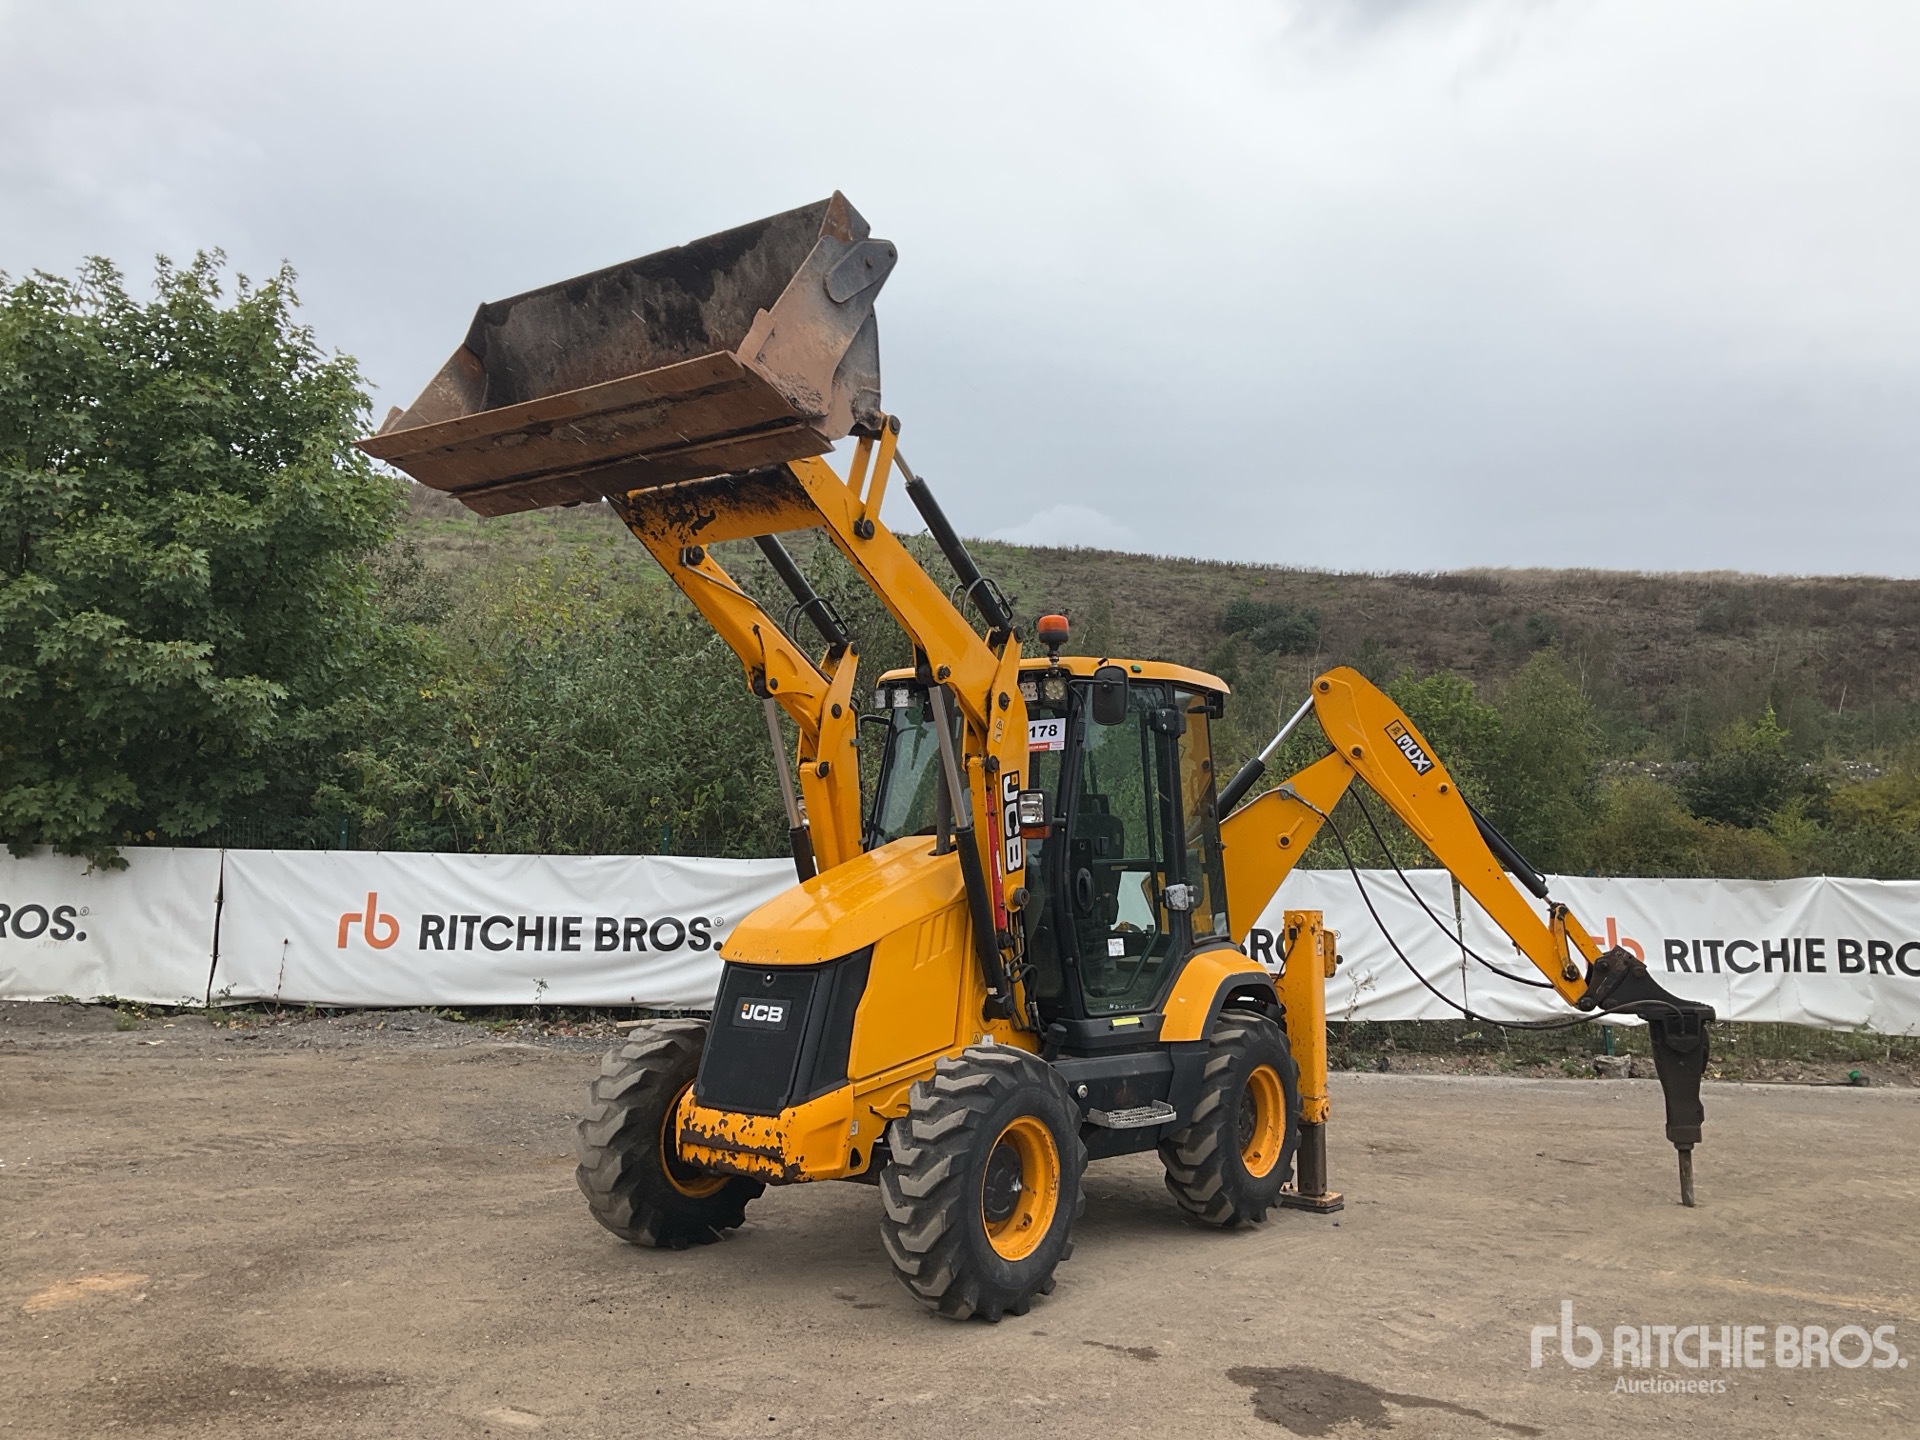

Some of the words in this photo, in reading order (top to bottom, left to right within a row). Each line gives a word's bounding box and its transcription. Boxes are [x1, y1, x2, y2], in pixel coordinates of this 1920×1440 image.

[1029, 724, 1058, 738] 178
[1396, 733, 1432, 772] 3CX
[1003, 775, 1022, 871] JCB
[337, 892, 399, 949] rb
[418, 914, 583, 951] RITCHIE
[1664, 938, 1827, 974] RITCHIE
[741, 1003, 783, 1022] JCB
